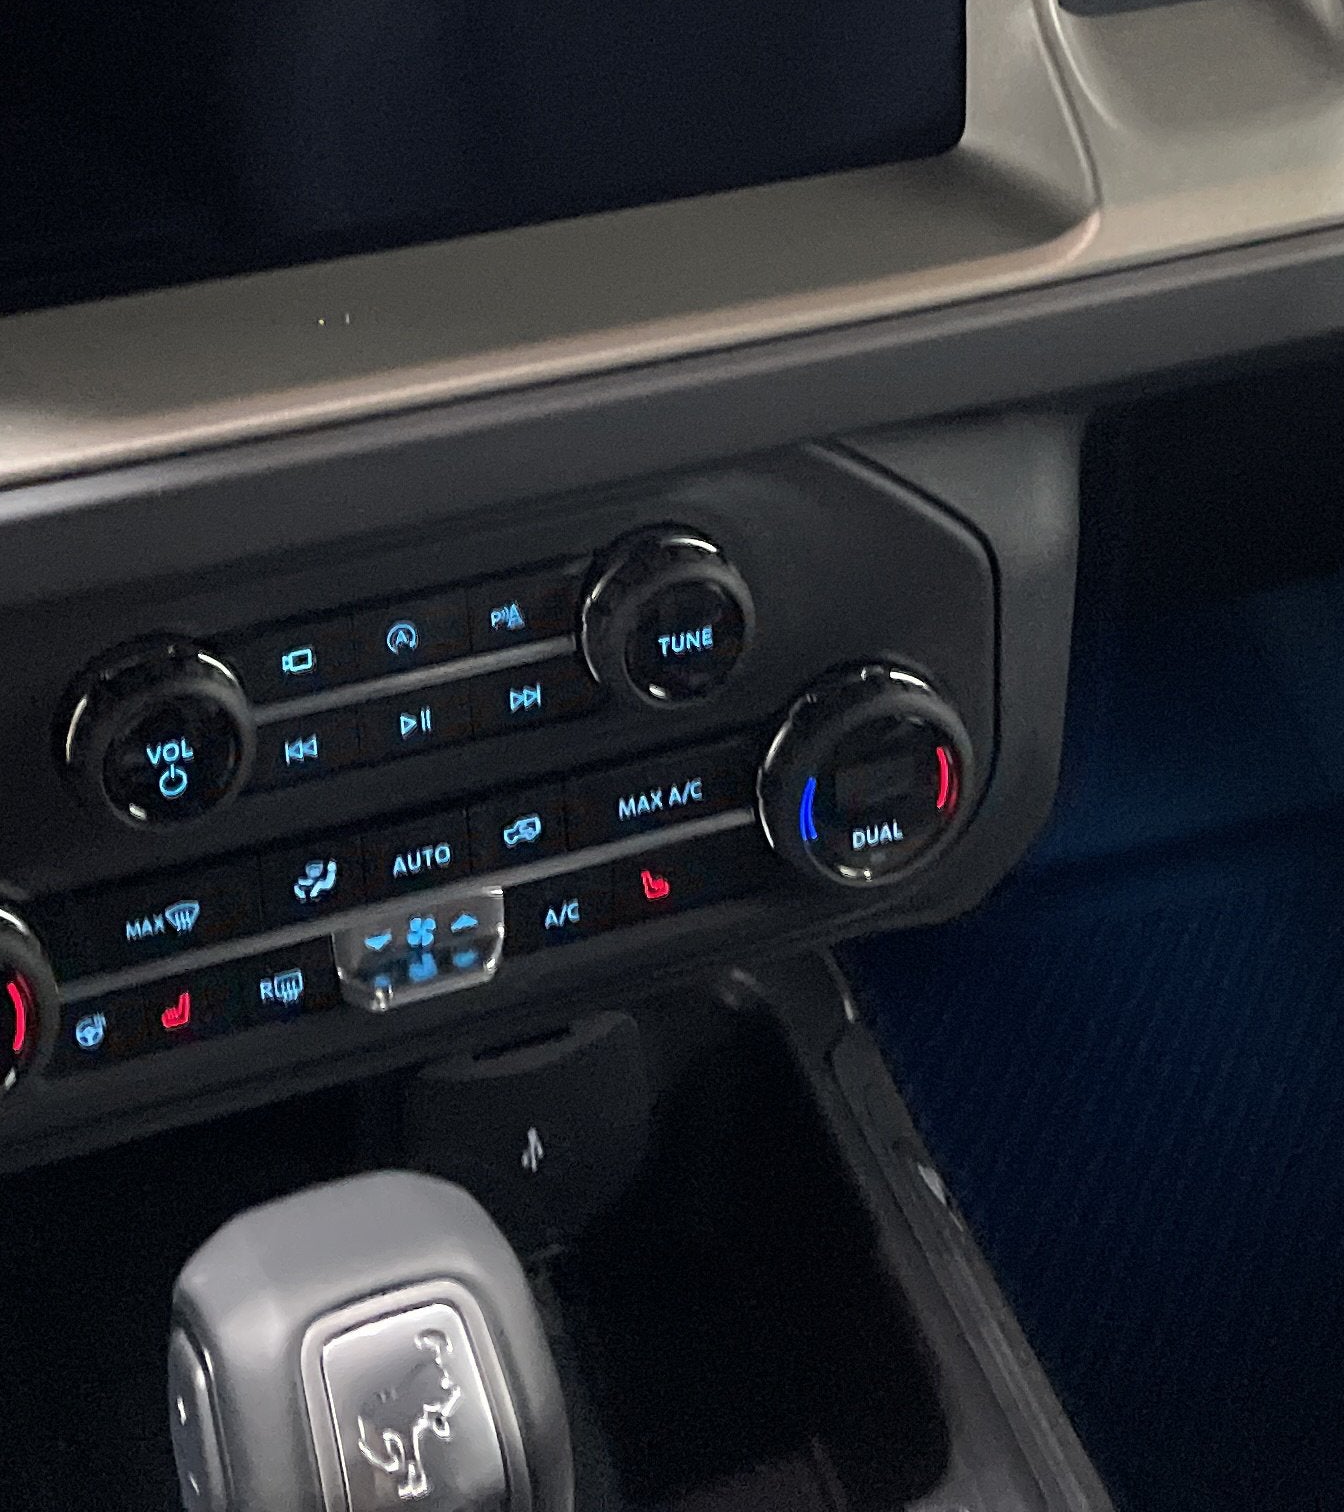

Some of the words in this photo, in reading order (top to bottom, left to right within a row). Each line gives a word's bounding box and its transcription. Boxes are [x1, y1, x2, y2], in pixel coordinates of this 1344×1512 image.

[658, 624, 713, 657] TUNE
[146, 736, 194, 767] VOL
[619, 788, 663, 821] MAX
[669, 777, 703, 807] A/C
[852, 819, 904, 851] DUAL
[393, 842, 451, 879] AUTO
[126, 913, 165, 941] MAX
[545, 898, 580, 929] A/C
